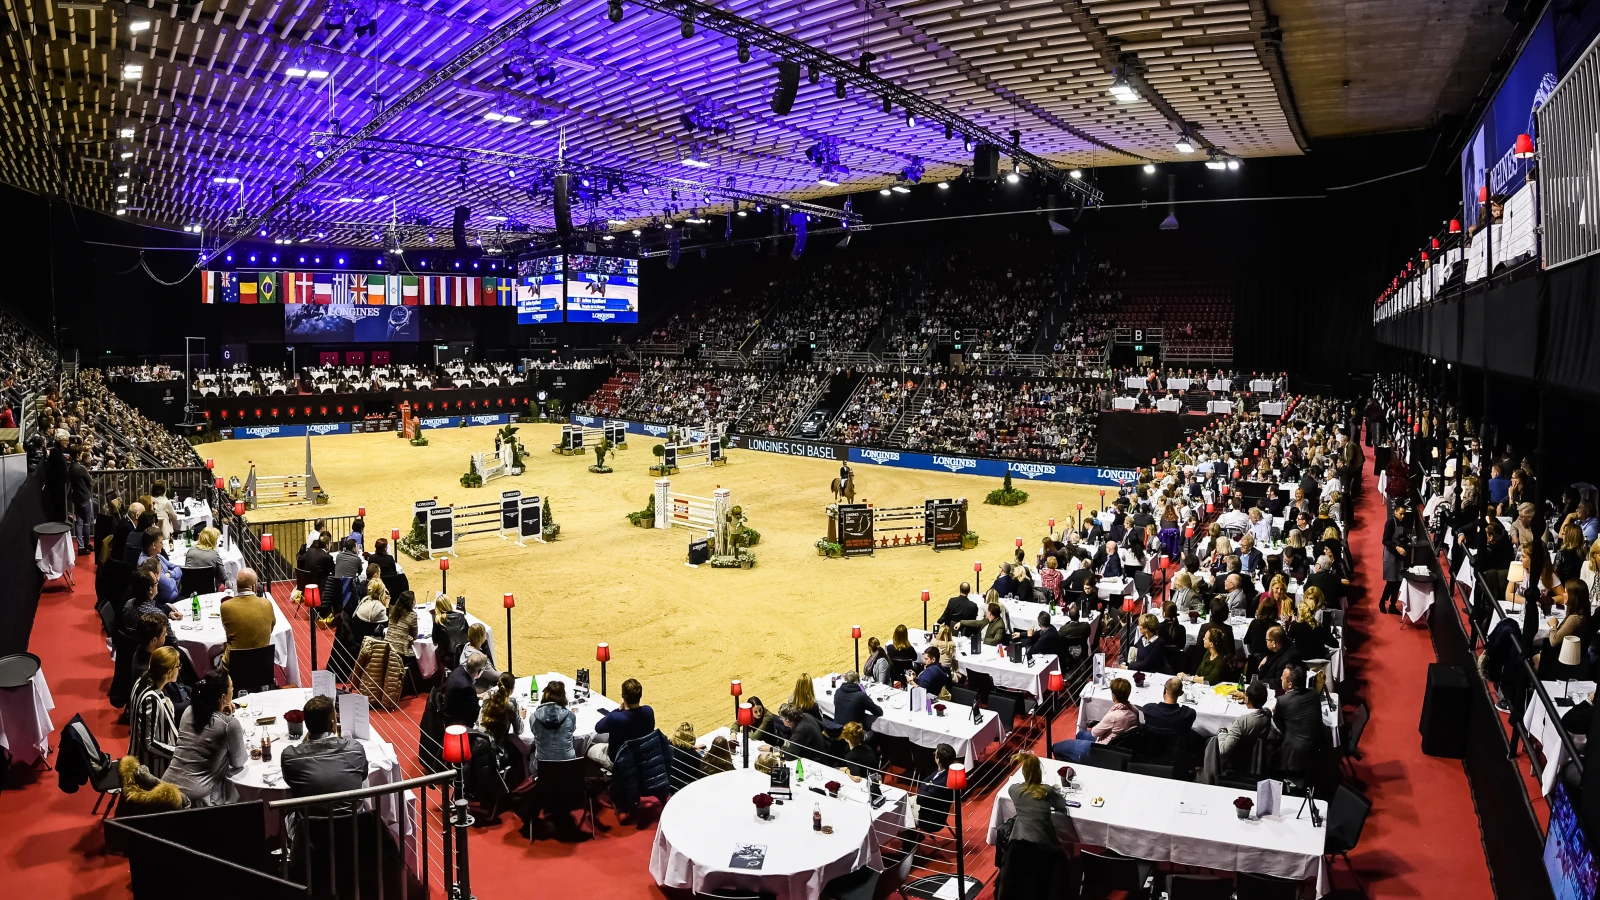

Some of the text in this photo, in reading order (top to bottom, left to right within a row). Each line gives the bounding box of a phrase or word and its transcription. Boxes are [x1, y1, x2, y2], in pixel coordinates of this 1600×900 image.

[328, 307, 381, 317] LONGINES
[699, 332, 704, 341] E
[809, 332, 816, 341] D
[954, 330, 961, 341] C
[1135, 330, 1142, 341] B
[224, 350, 230, 360] G
[464, 347, 470, 355] F
[420, 417, 449, 426] LONGINES
[246, 426, 280, 435] LONGINES
[306, 423, 339, 432] LONGINES
[643, 424, 667, 433] LONGINES
[748, 439, 837, 460] LONGINES CSI BASEL
[860, 449, 900, 461] LONGINES
[932, 456, 976, 468] LONGINES
[1007, 462, 1056, 474] LONGINES
[1097, 469, 1139, 481] LONGIN
